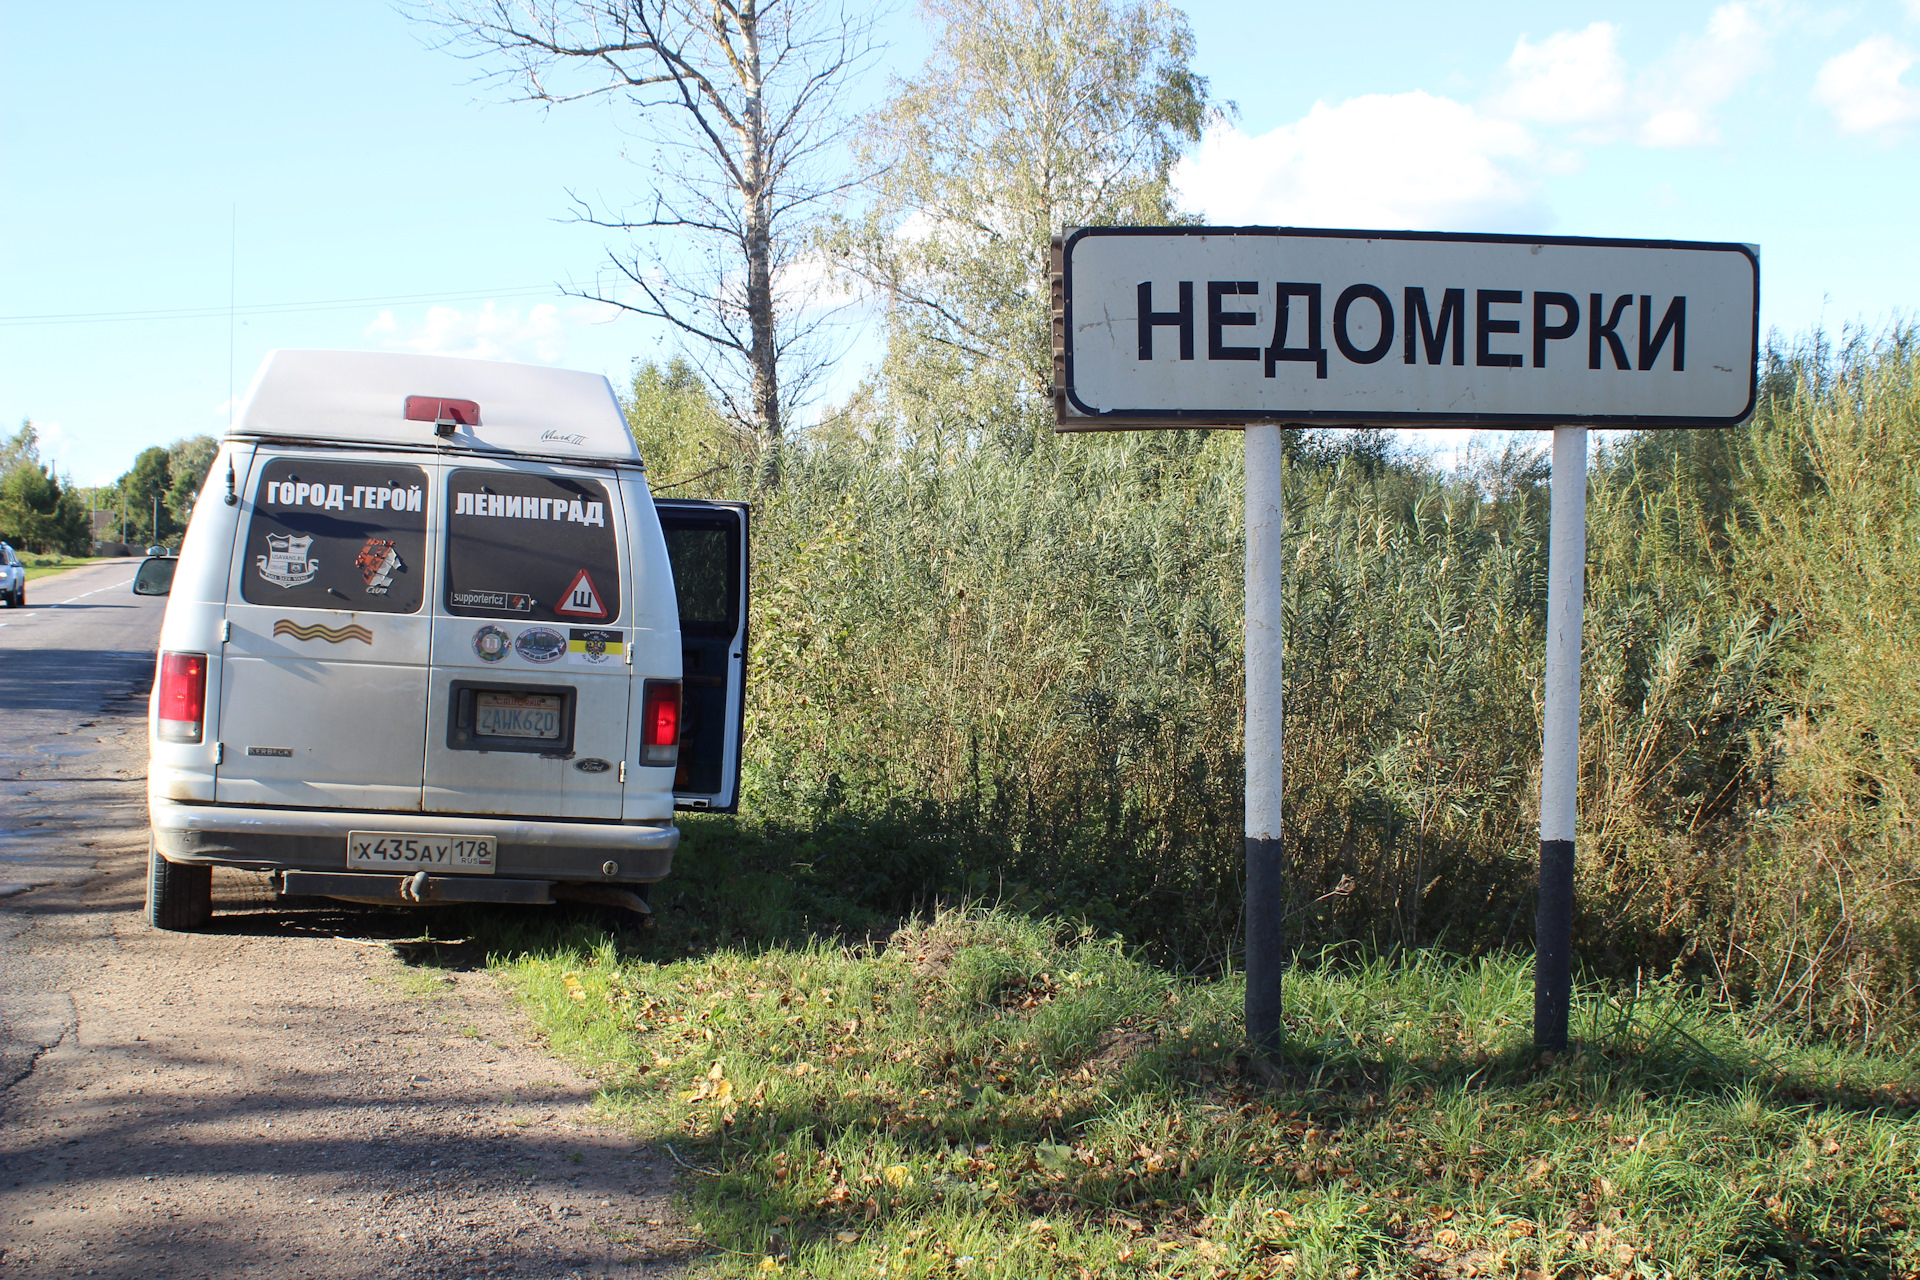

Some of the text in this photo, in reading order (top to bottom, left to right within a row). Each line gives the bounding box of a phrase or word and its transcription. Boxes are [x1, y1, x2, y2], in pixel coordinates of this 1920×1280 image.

[1137, 281, 1686, 379] НЕДОМЕРКИ
[540, 429, 573, 442] Mark
[267, 480, 604, 527] ГОРОД-ГЕРОЙ ЛЕНИНГРАД
[453, 592, 504, 606] supporterfcz
[573, 590, 592, 608] Ш
[249, 748, 290, 757] KERBECK
[582, 761, 604, 772] Ford
[454, 841, 488, 857] 178
[461, 857, 479, 865] RUS
